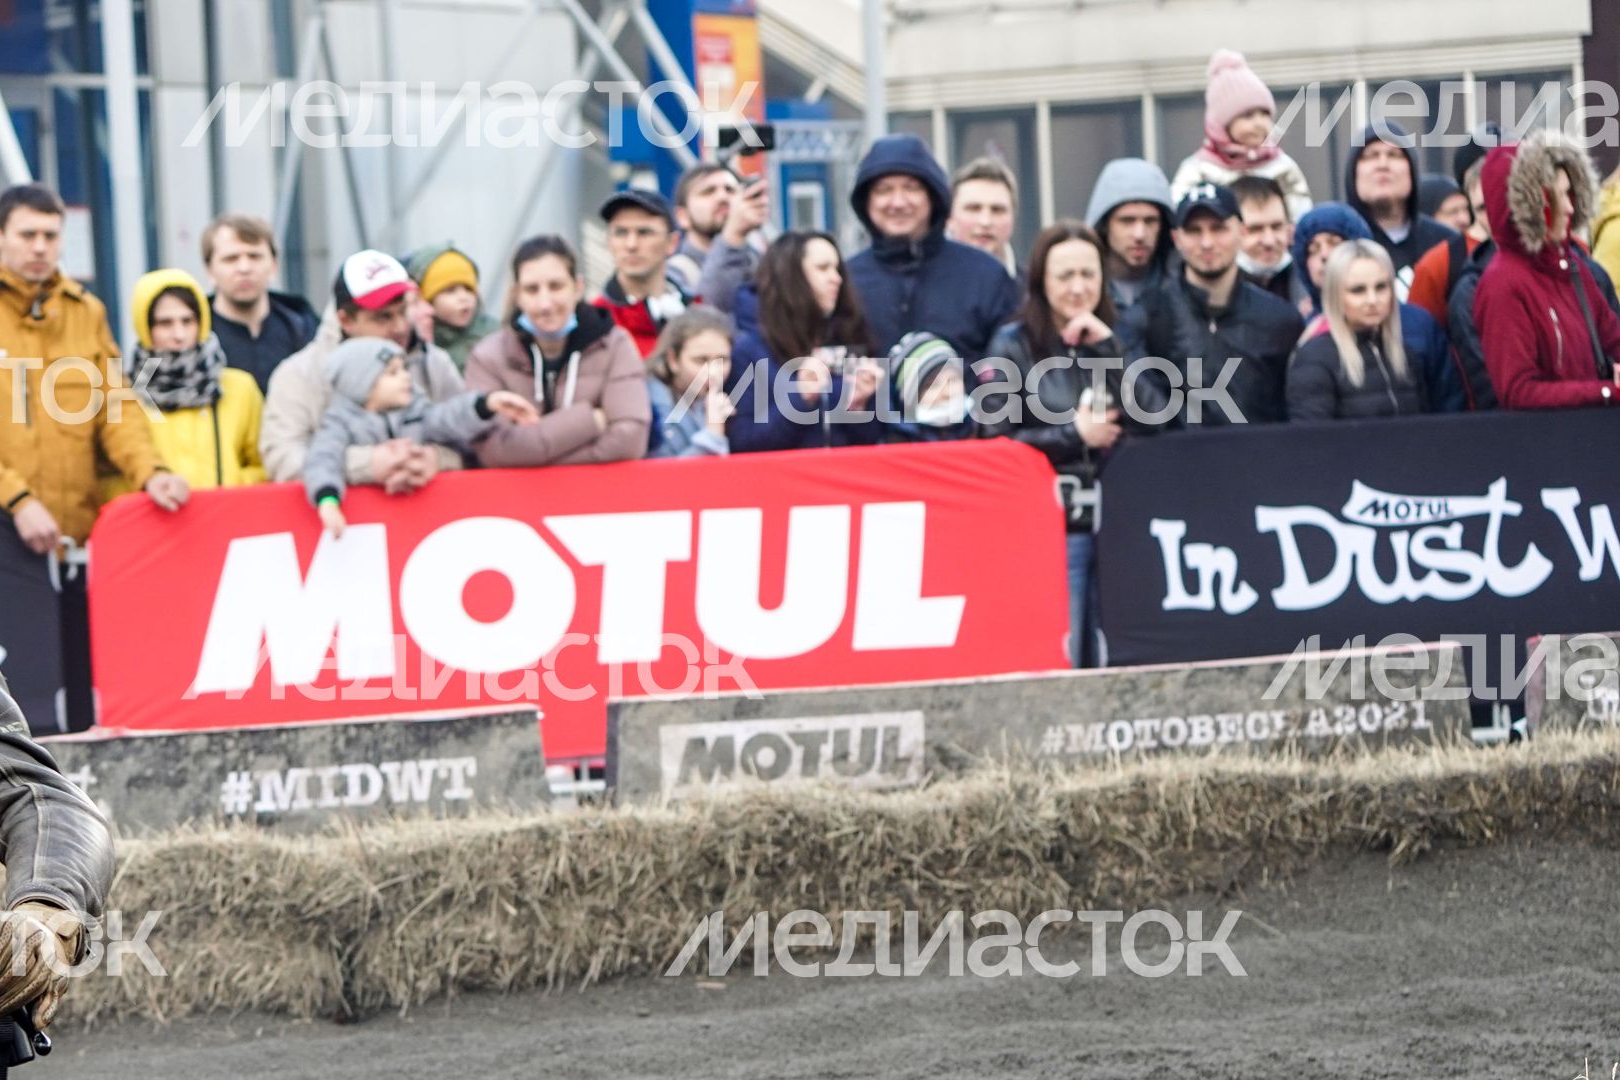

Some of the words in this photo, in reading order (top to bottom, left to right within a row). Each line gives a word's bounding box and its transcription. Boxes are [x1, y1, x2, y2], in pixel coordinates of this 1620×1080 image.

[1361, 498, 1454, 522] MOTUL
[192, 501, 966, 695] MOTUL
[679, 716, 913, 782] MOTUL
[220, 756, 477, 814] #MIDWT
